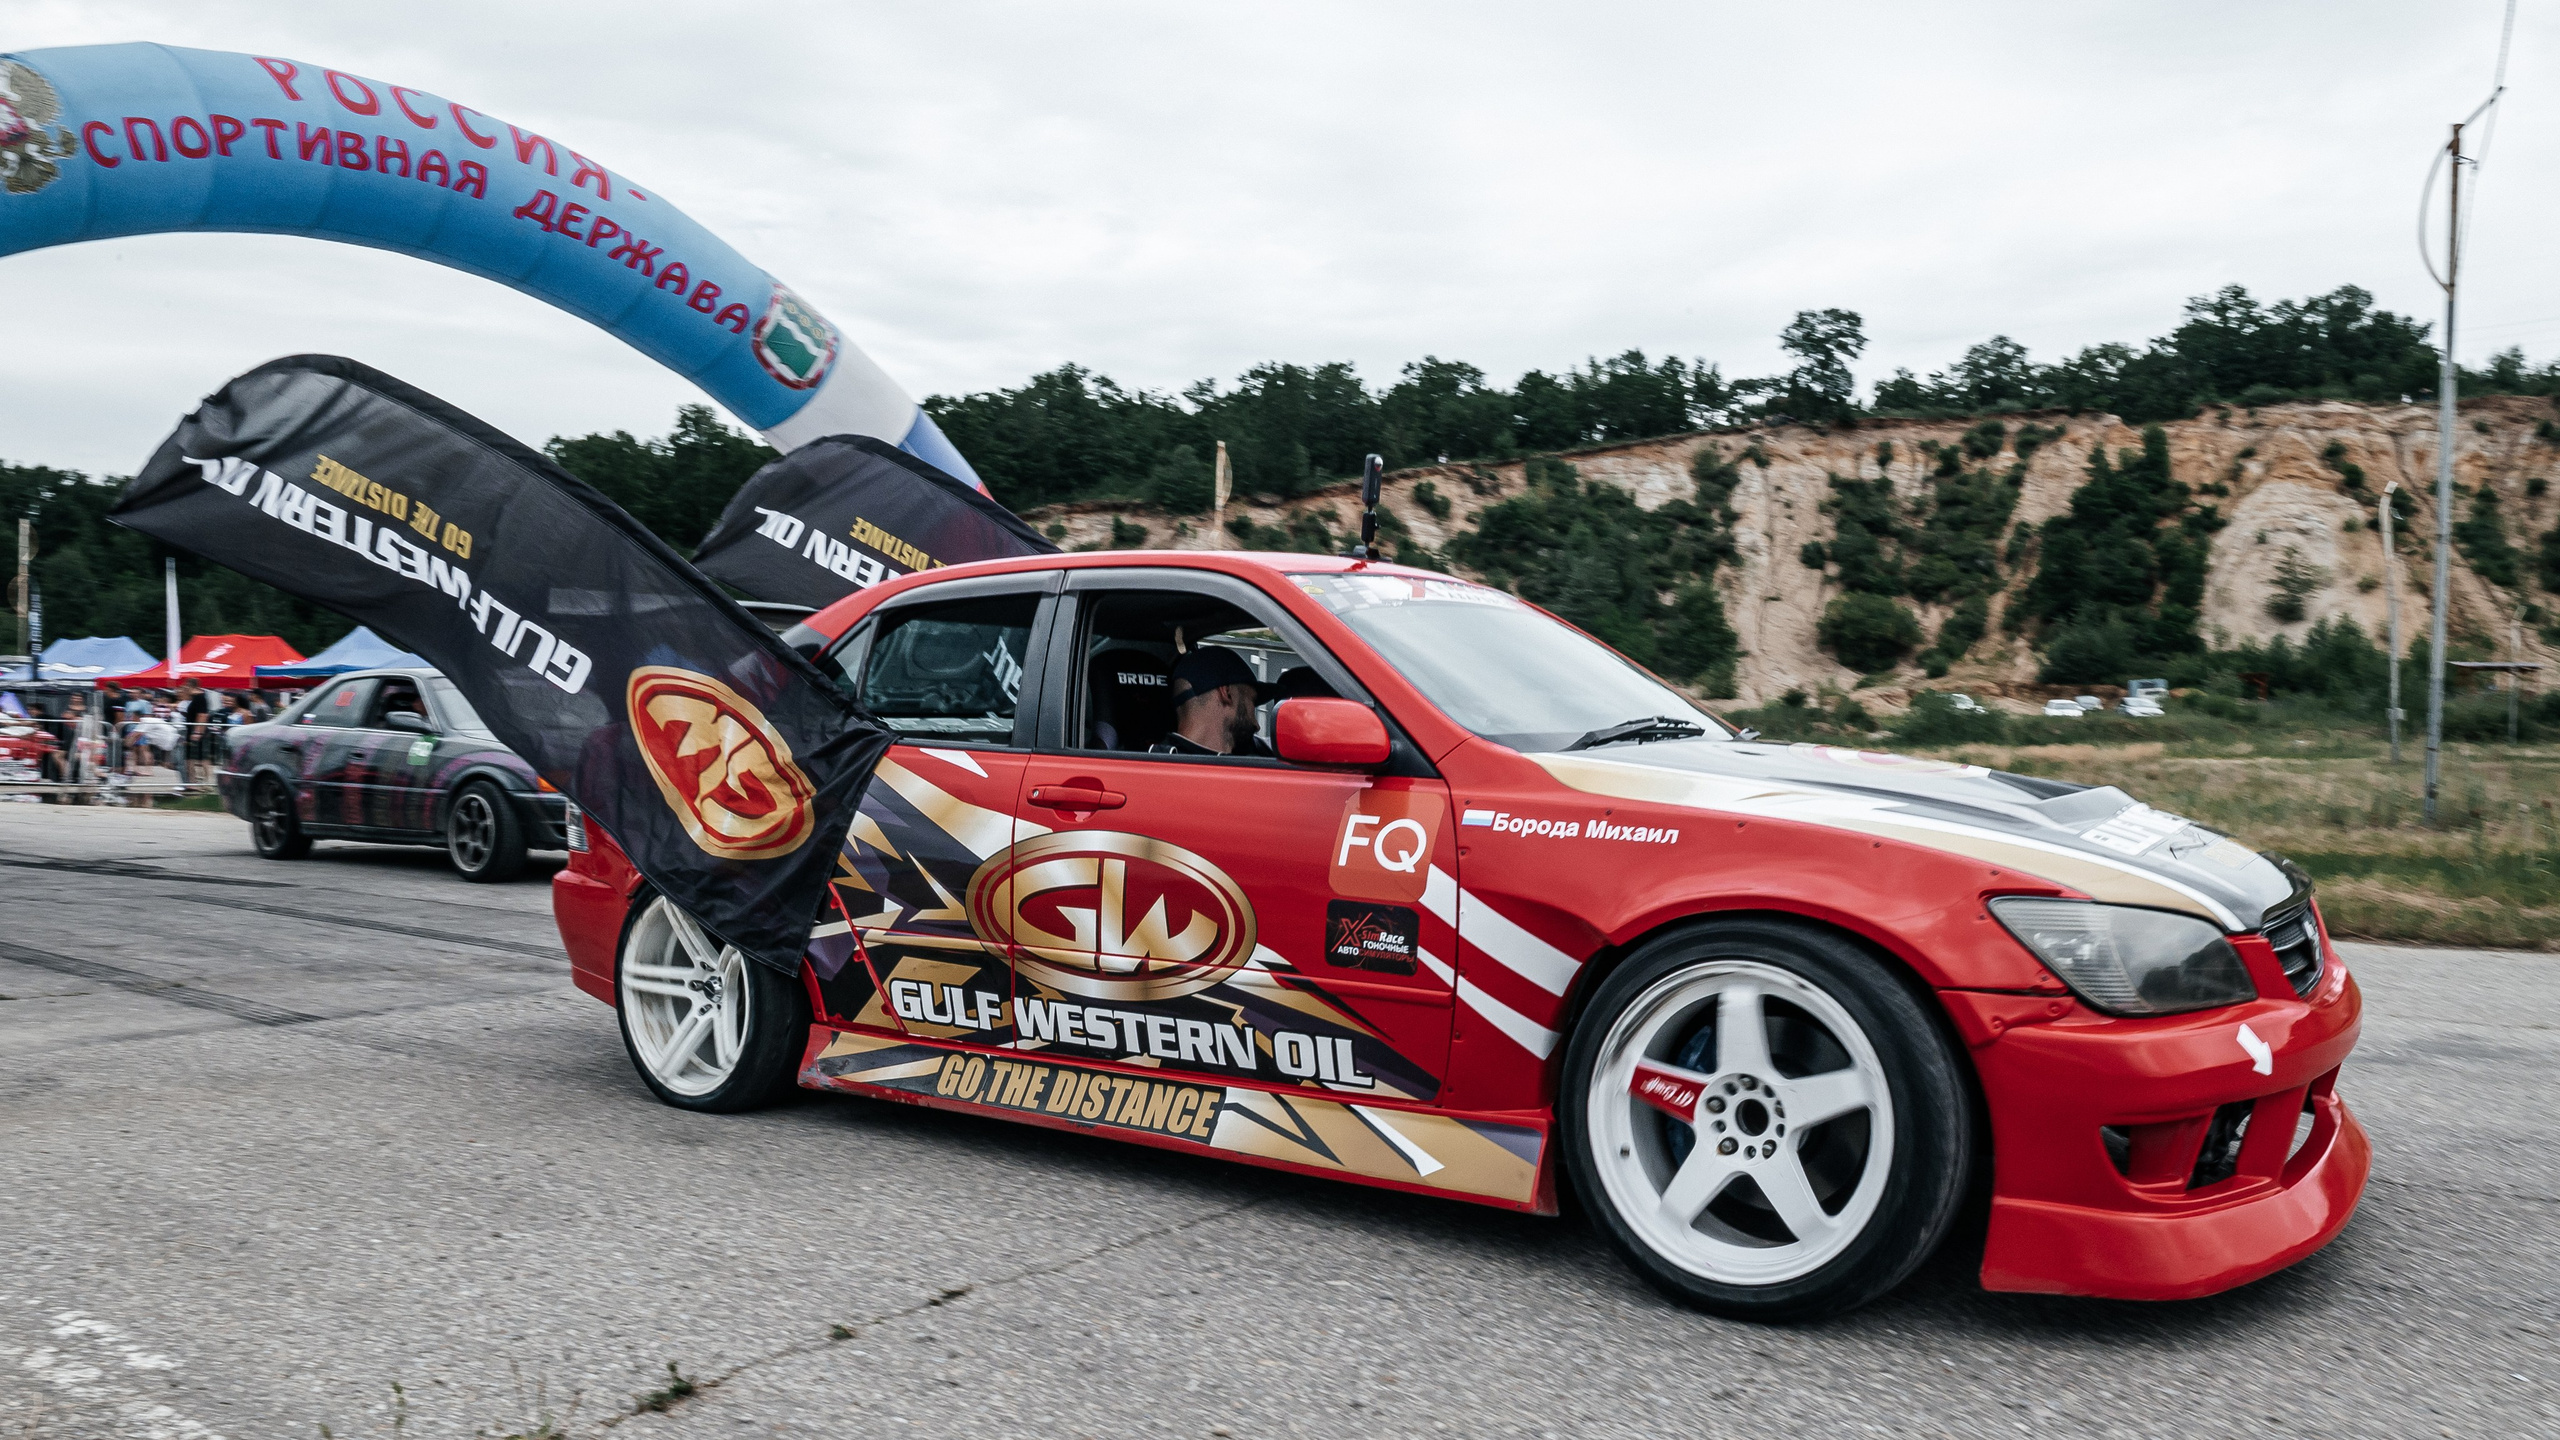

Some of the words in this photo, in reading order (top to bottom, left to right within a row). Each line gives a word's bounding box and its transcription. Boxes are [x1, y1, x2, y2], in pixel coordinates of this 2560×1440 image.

[82, 114, 488, 200] СПОРТИВНАЯ
[514, 189, 750, 335] ДЕРЖАВА
[309, 453, 409, 523] DISTANCE
[247, 469, 474, 610] WESTERN
[409, 500, 442, 543] THE
[441, 521, 473, 560] GO
[848, 515, 931, 574] DISTANCE
[469, 590, 594, 695] GULF
[1116, 672, 1169, 687] BRIDE
[1337, 813, 1428, 874] FQ
[1492, 812, 1578, 839] Борода
[1584, 819, 1680, 845] Михаил
[992, 858, 1220, 974] GW
[1362, 940, 1410, 954] ГОНОЧНЫЕ
[891, 980, 1002, 1033] GULF
[1015, 997, 1258, 1072] WESTERN
[1273, 1029, 1376, 1090] OIL
[937, 1053, 983, 1101] GO
[983, 1059, 1048, 1112] THE
[1052, 1071, 1224, 1138] DISTANCE
